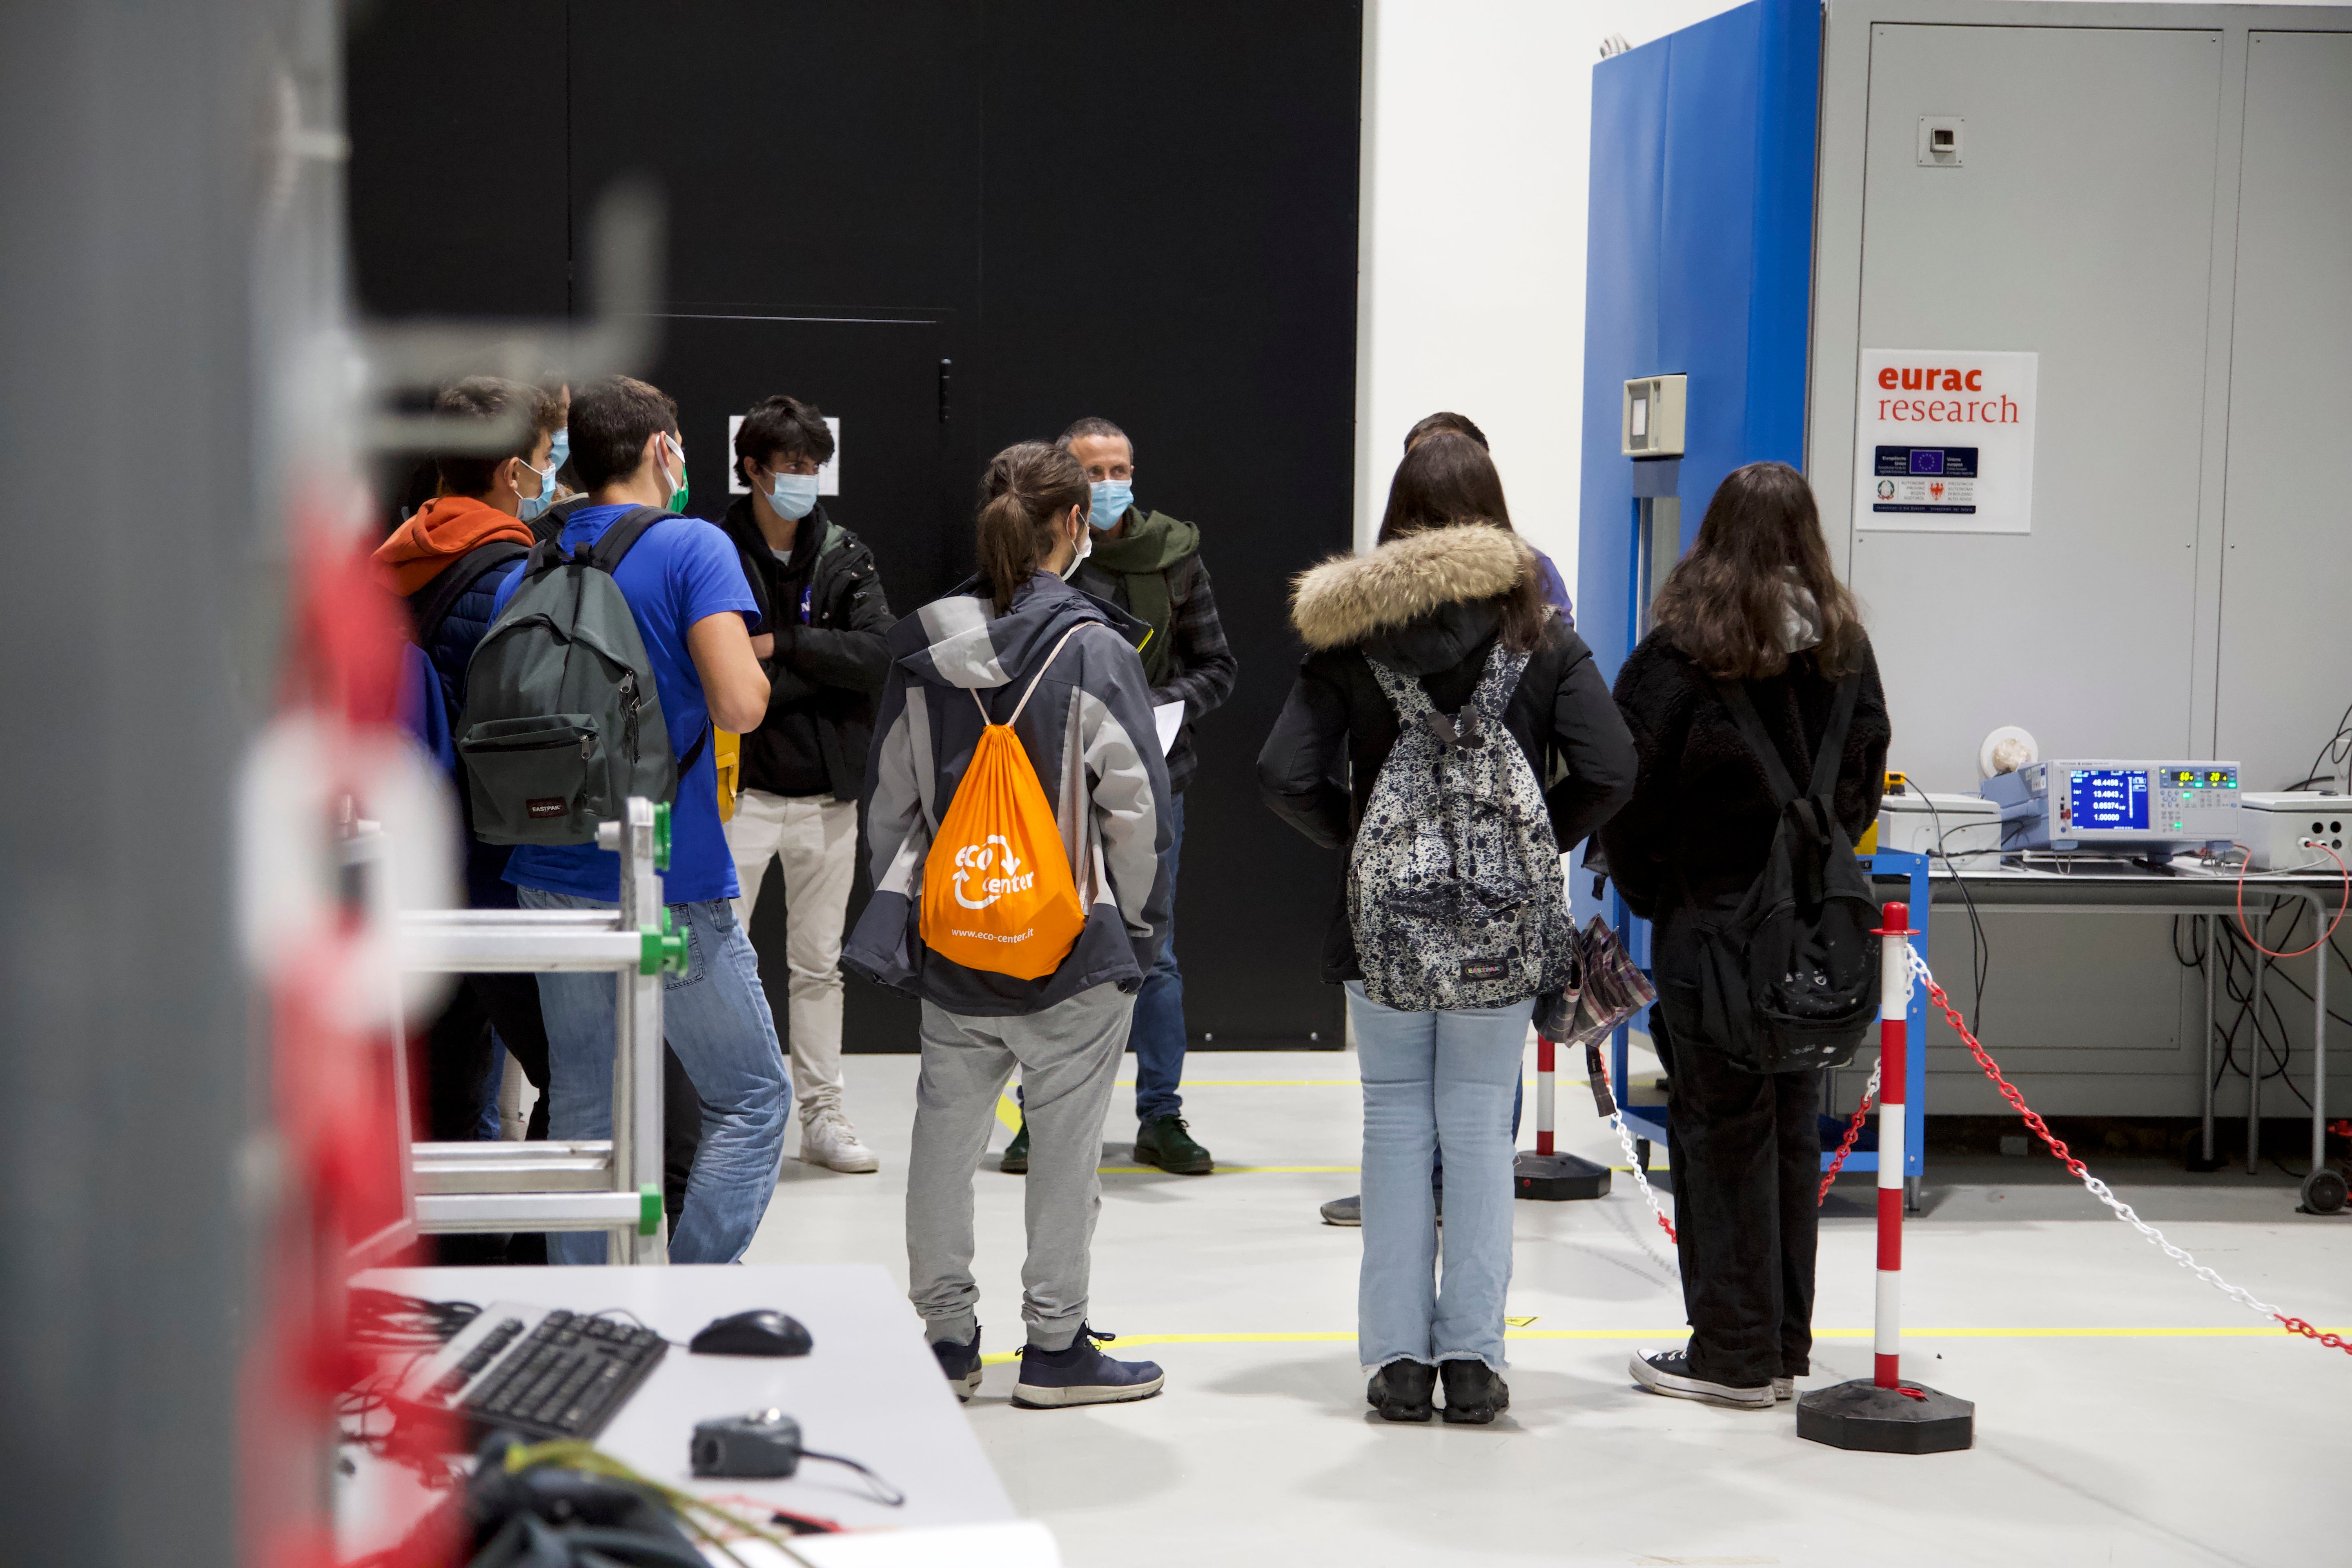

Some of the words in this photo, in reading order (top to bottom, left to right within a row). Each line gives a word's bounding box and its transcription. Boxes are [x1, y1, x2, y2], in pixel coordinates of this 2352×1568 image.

[1878, 367, 1982, 392] eurac
[1878, 394, 2019, 423] research
[955, 845, 993, 871] eco
[982, 871, 1034, 894] center
[951, 928, 1034, 943] www.eco-center.it
